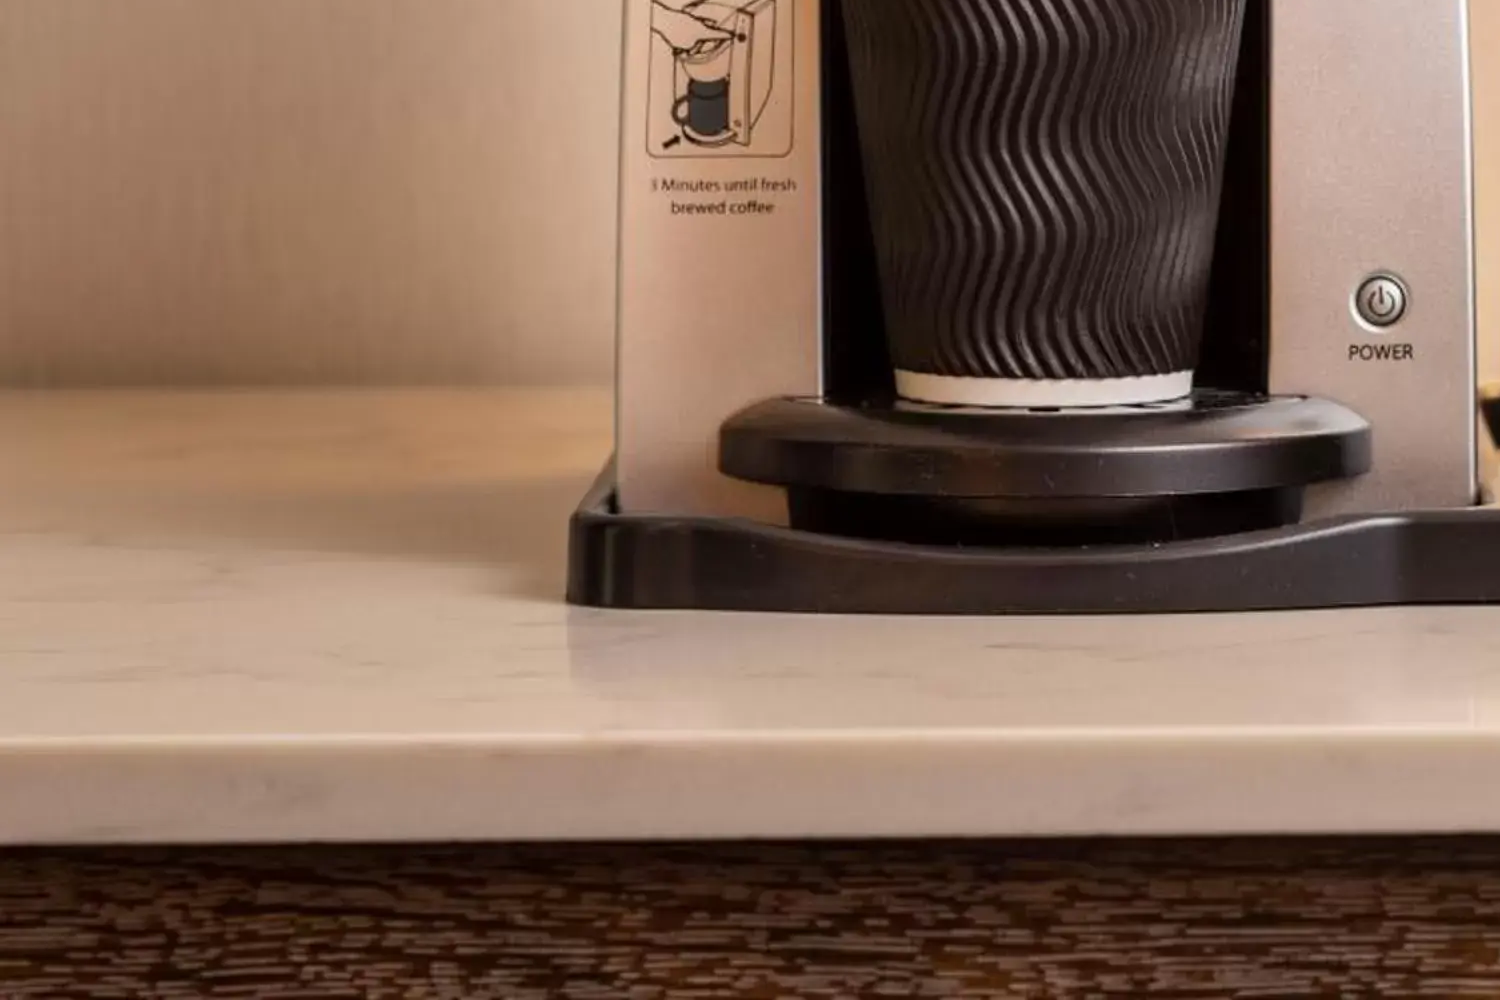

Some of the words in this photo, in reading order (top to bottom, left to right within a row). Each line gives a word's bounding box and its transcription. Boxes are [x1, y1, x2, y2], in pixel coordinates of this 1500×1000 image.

[661, 178, 721, 192] Minutes
[724, 178, 758, 192] until
[761, 177, 797, 192] fresh
[671, 200, 726, 214] brewed
[729, 200, 775, 214] coffee
[1348, 343, 1413, 360] POWER
